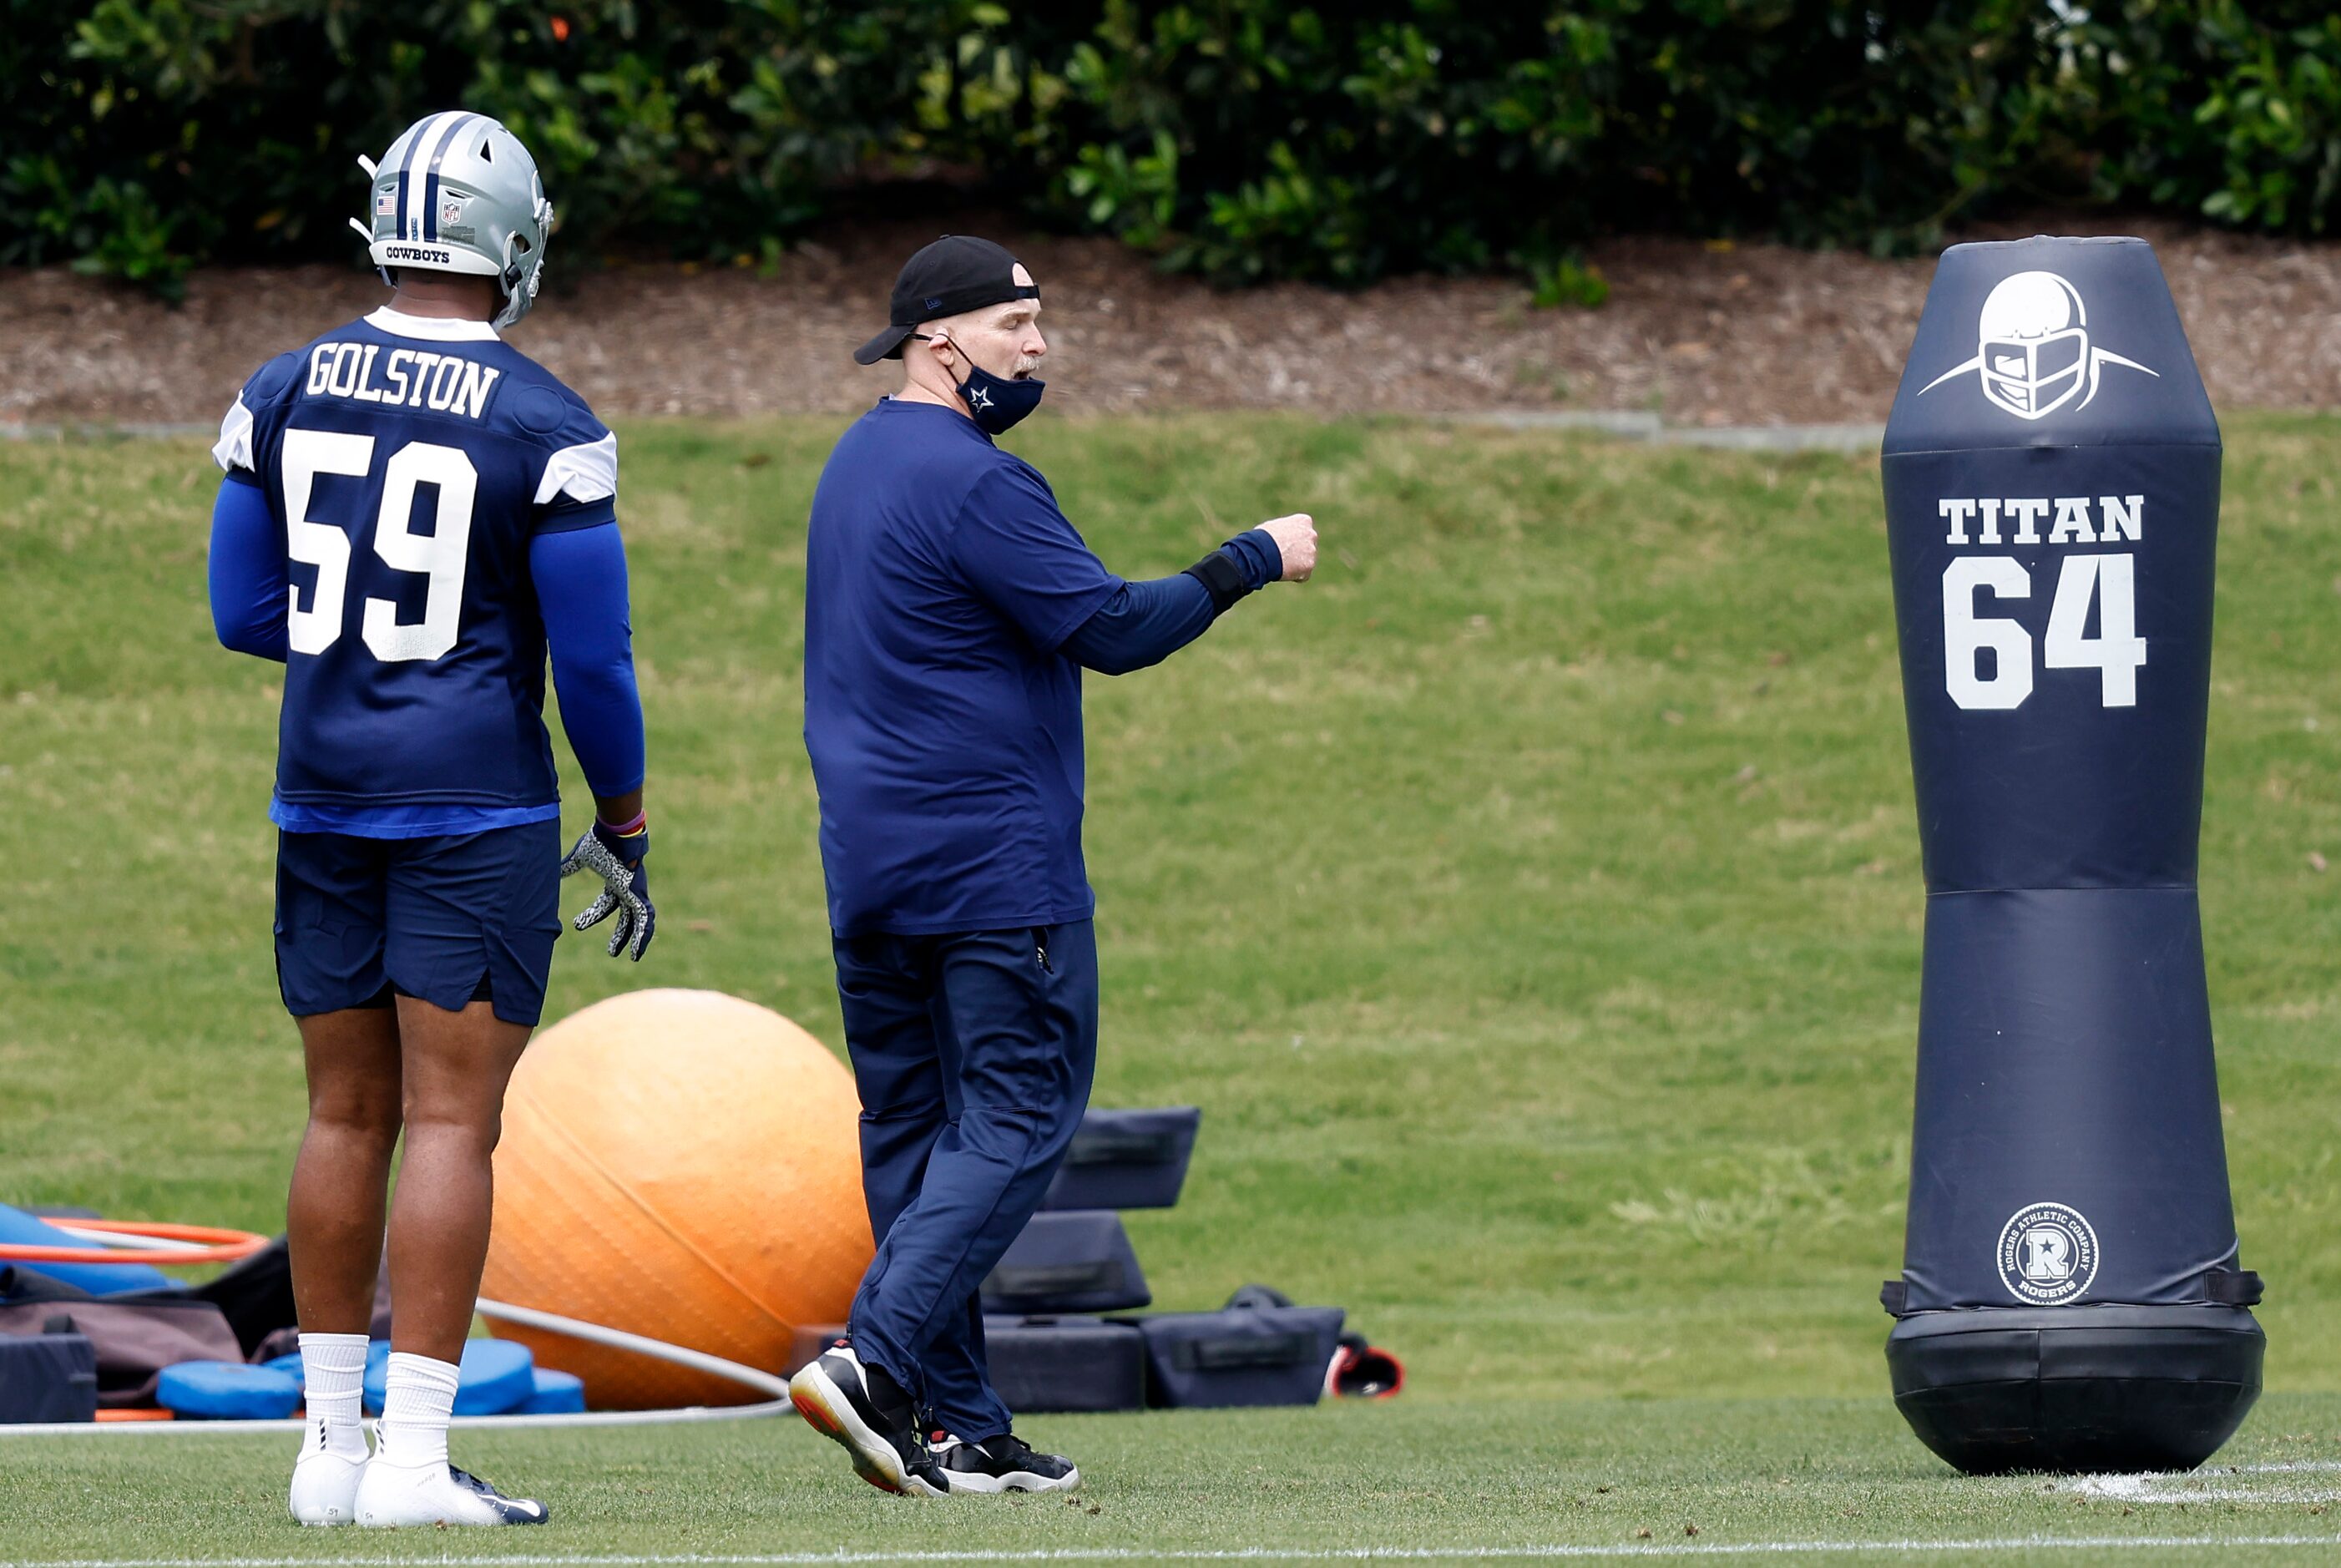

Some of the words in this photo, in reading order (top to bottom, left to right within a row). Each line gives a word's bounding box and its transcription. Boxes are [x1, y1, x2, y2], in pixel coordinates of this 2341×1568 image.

[444, 210, 459, 220] NFL
[387, 247, 449, 263] COWBOYS
[306, 342, 499, 418] GOLSTON
[281, 428, 478, 662] 59
[1939, 495, 2144, 544] TITAN
[1942, 553, 2146, 710] 64
[2005, 1229, 2020, 1272] ROGERS
[2017, 1211, 2068, 1231] ATHLETIC
[2068, 1220, 2091, 1271] COMPANY
[2025, 1228, 2069, 1279] R
[2018, 1280, 2076, 1298] ROGERS
